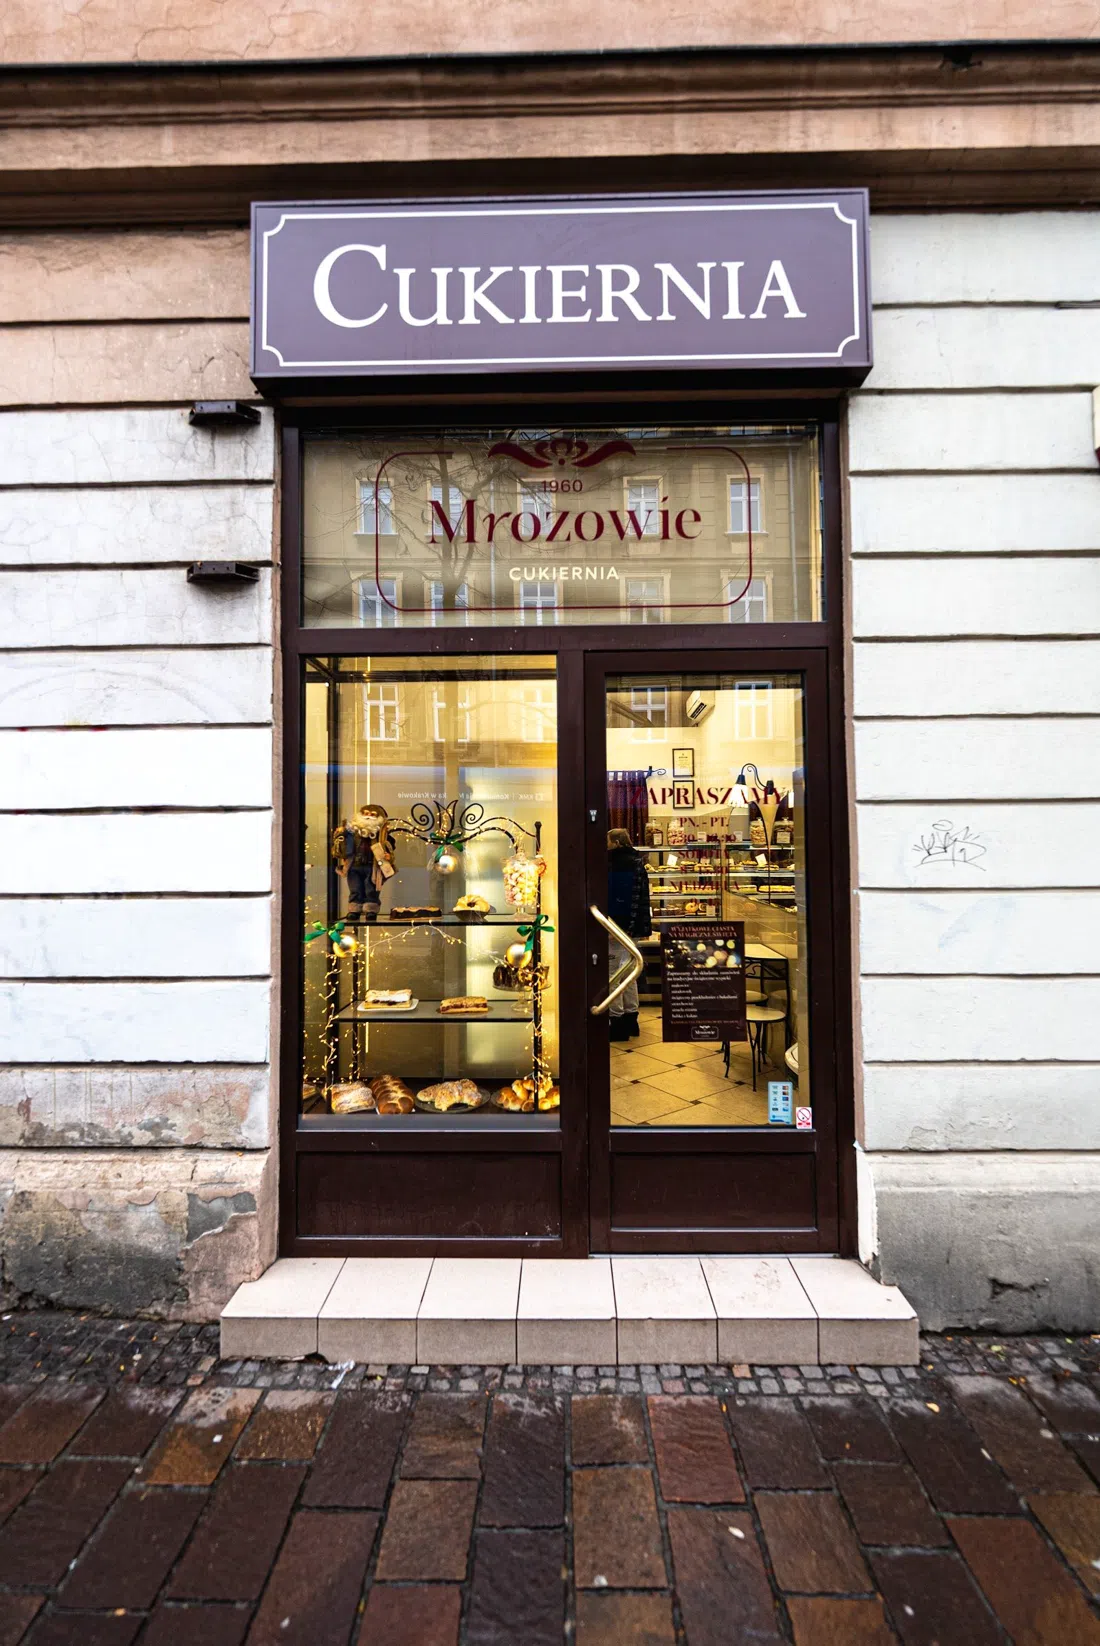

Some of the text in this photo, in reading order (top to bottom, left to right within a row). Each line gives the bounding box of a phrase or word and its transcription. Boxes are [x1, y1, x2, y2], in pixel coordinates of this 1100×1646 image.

[313, 243, 807, 328] CUKIERNIA
[541, 479, 583, 493] 1960
[428, 496, 703, 544] Mrozowie
[509, 566, 620, 581] CUKIERNIA
[629, 787, 786, 805] ZAPRASZAMY
[679, 817, 699, 827] PN.
[711, 817, 730, 827] PT.
